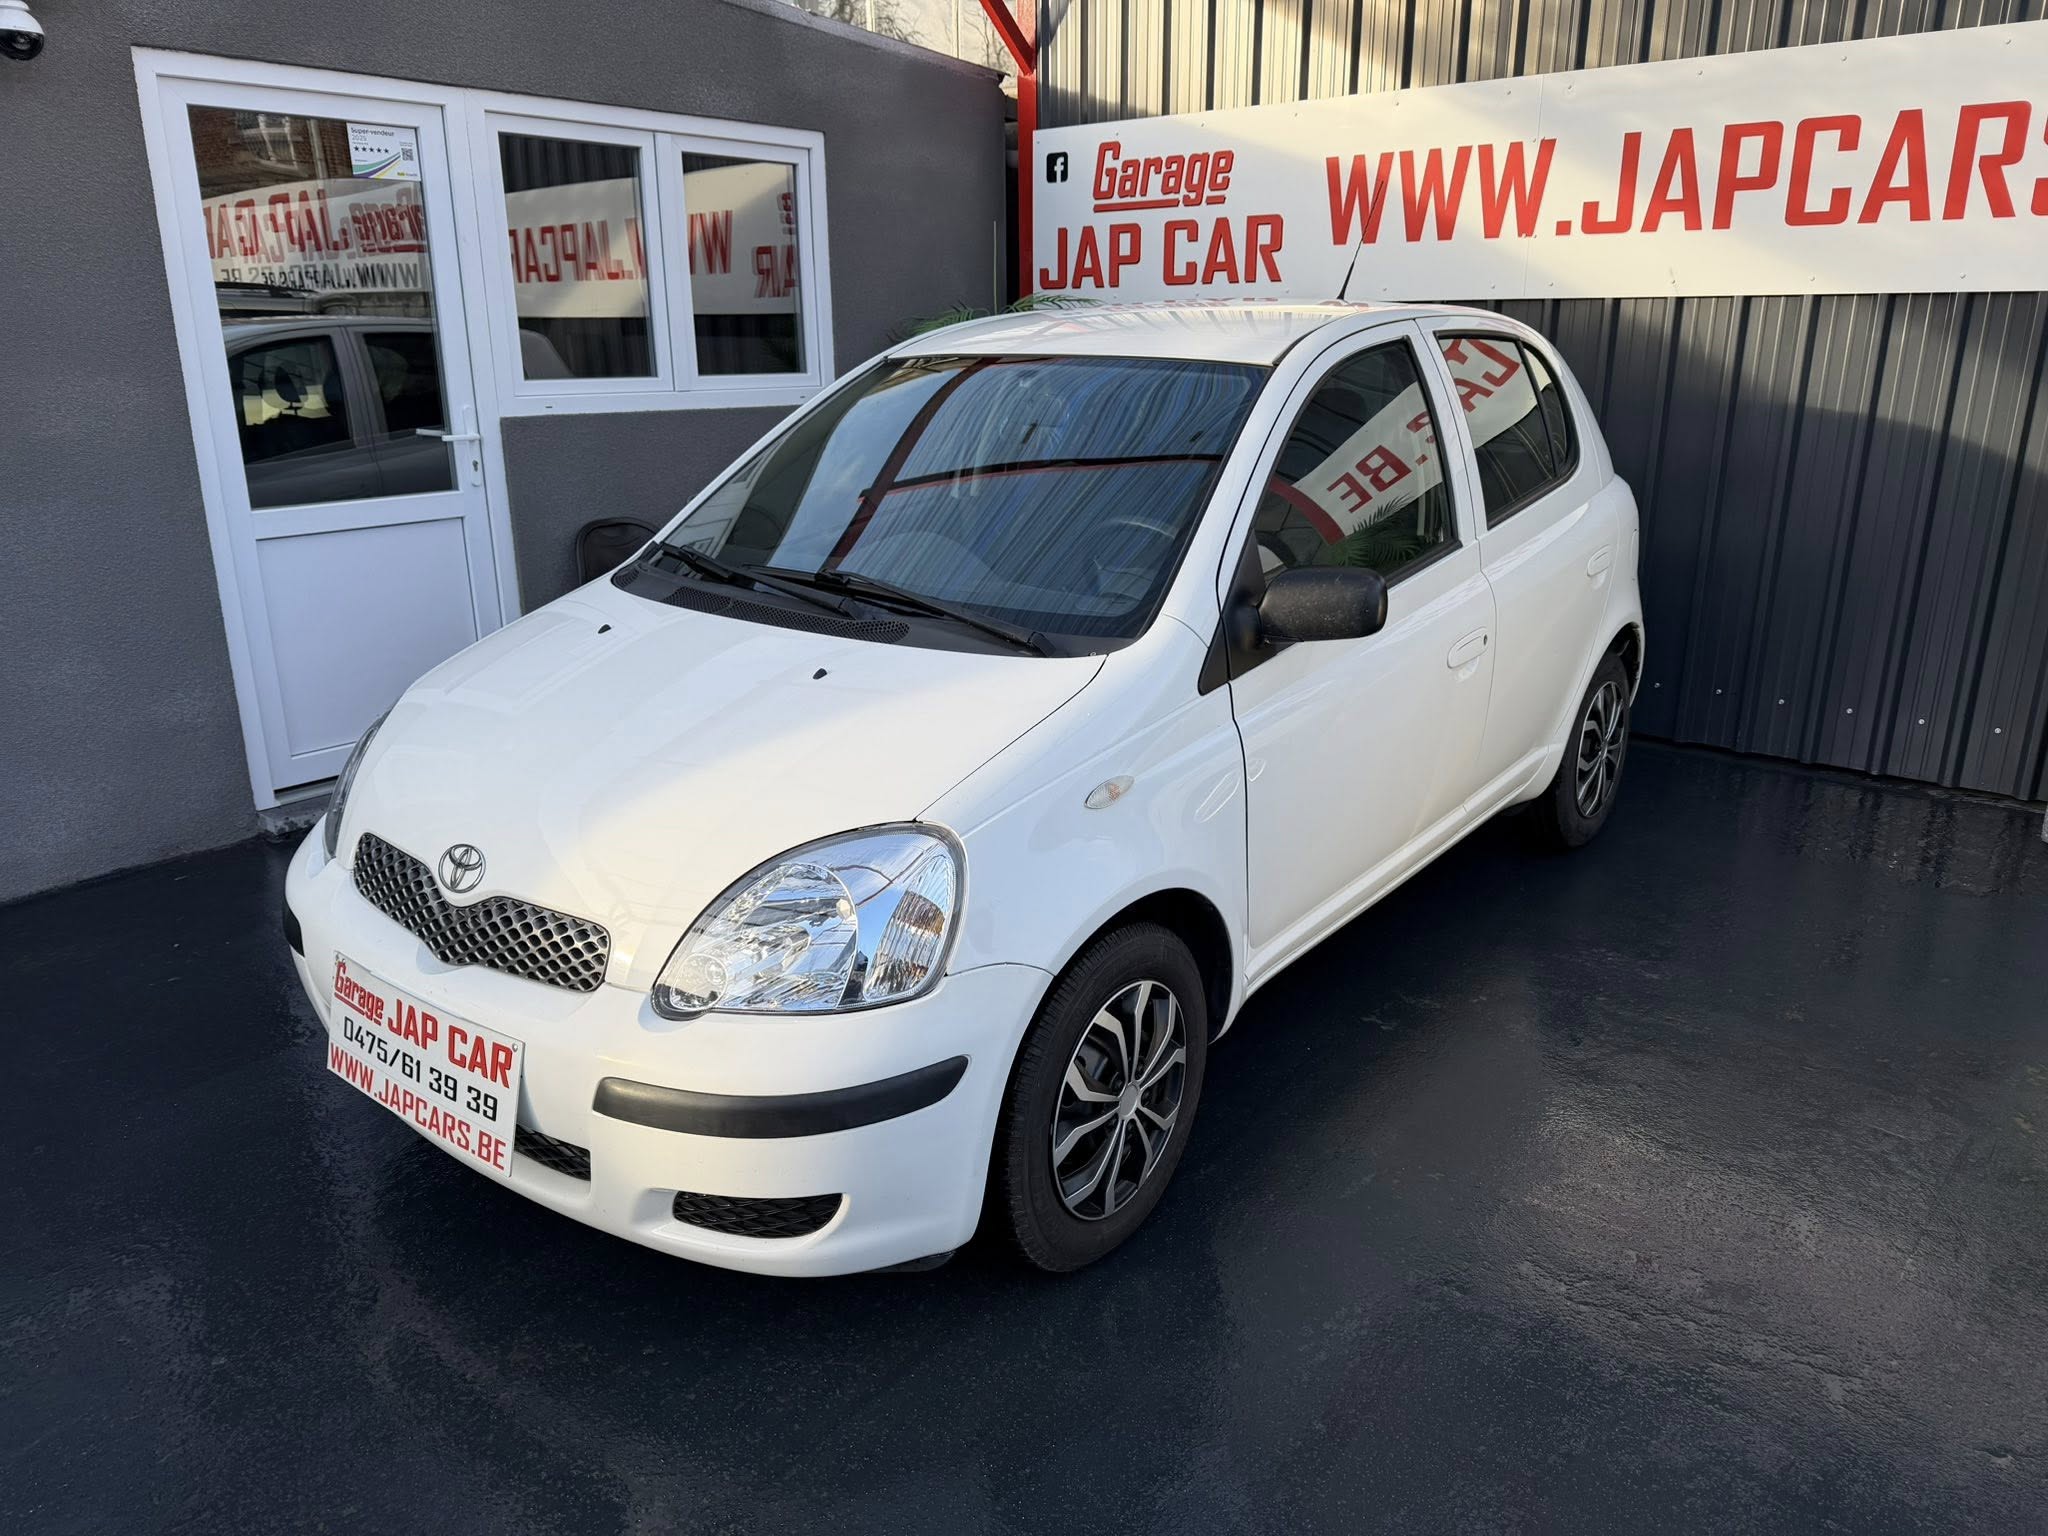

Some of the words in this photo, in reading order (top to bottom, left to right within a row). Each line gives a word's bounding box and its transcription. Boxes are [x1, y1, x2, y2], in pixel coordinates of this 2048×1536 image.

[350, 127, 395, 137] Super-vendeur
[1093, 141, 1235, 209] Garage
[1326, 100, 2048, 246] WWW.JAPCAR
[1040, 223, 1142, 289] JAP
[1163, 214, 1284, 286] CAR
[334, 961, 385, 1026] Garage
[387, 998, 438, 1050] JAP
[448, 1024, 514, 1089] CAR
[343, 1016, 421, 1083] 0475/61
[429, 1067, 458, 1102] 39
[466, 1085, 498, 1122] 39
[330, 1042, 507, 1171] WWW.JAPCARS.BE
